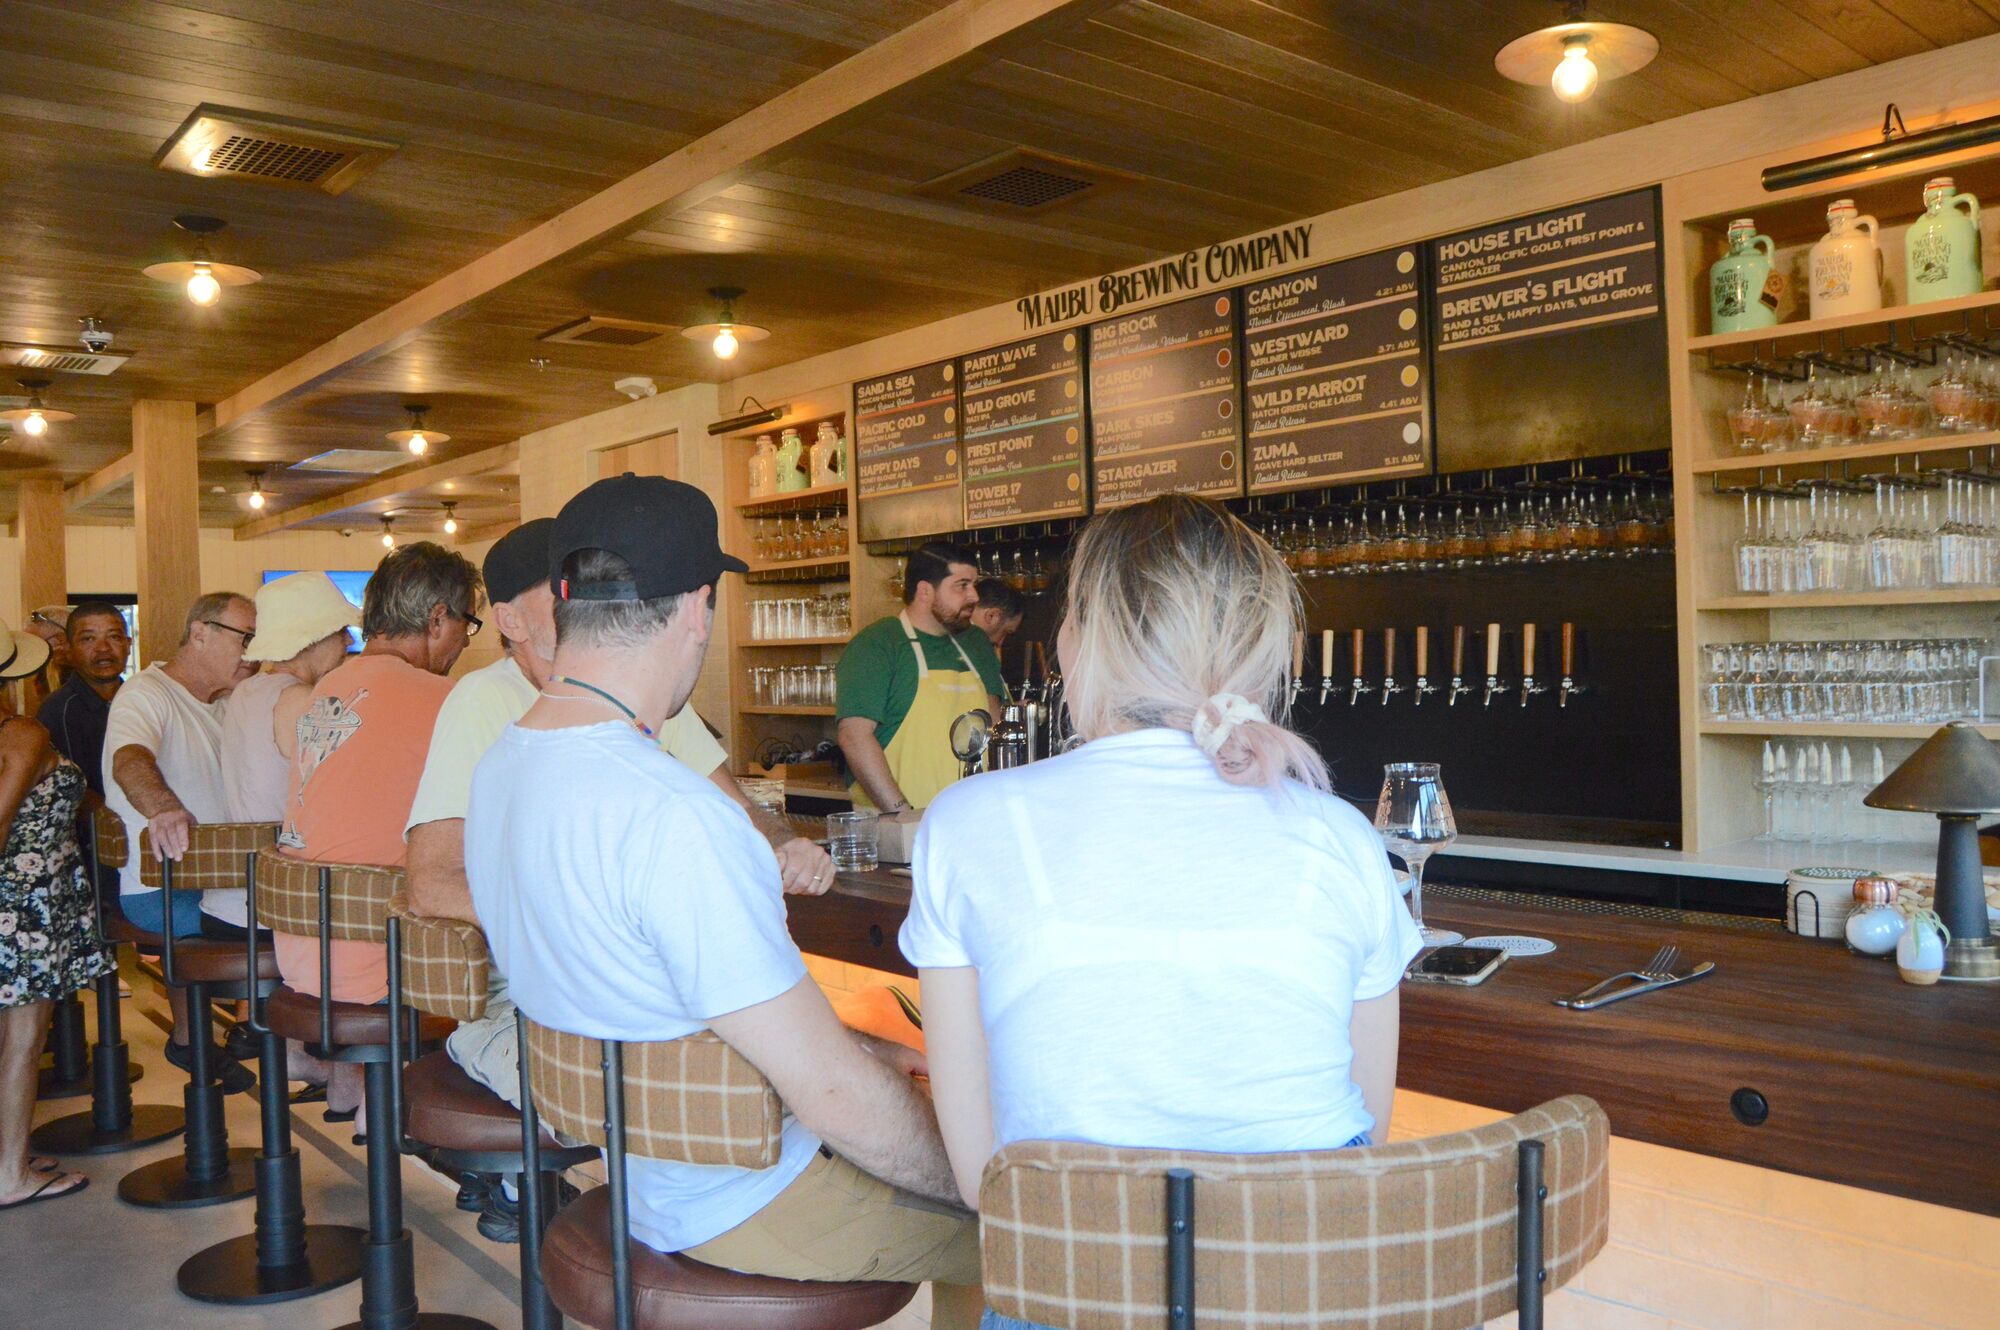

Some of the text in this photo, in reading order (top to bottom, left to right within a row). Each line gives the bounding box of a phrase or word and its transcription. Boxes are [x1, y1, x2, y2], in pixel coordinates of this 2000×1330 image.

[1440, 212, 1586, 261] HOUSE FLIGHT
[1487, 247, 1528, 264] PACIFIC
[1530, 240, 1563, 255] GOLD,
[1565, 231, 1597, 247] FIRST
[1598, 223, 1634, 240] POINT
[1017, 223, 1313, 331] MALIBU BREWING COMPANY
[1441, 263, 1501, 284] STARGAZER
[1248, 275, 1318, 306] CANYON
[1395, 282, 1415, 294] ABV
[1442, 266, 1627, 319] BREWER'S FLIGHT
[1273, 297, 1300, 310] LAGER
[1443, 319, 1472, 333] SAND
[1507, 304, 1543, 320] HAPPY
[1545, 299, 1577, 313] DAYS,
[1579, 292, 1608, 306] WILD
[1611, 283, 1653, 300] GROVE
[1093, 314, 1157, 342] BIG ROCK
[1452, 329, 1469, 341] BIG
[1471, 324, 1501, 337] ROCK
[1250, 323, 1350, 357] WESTWARD
[1398, 339, 1417, 350] ABV
[965, 344, 1037, 373] PARTY WAVE
[1251, 345, 1323, 368] BERLINER WEISSE
[1095, 365, 1153, 388] CARBON
[1277, 363, 1305, 376] Release
[858, 382, 885, 399] SAND
[895, 375, 915, 390] SEA
[1252, 374, 1368, 409] WILD PARROT
[966, 389, 1036, 415] WILD GROVE
[1252, 393, 1363, 420] HATCH GREEN CHILE LAGER
[1400, 396, 1420, 407] ABV
[860, 414, 926, 437] PACIFIC GOLD
[1096, 410, 1175, 436] DARK SKIES
[1279, 416, 1306, 428] Release
[967, 435, 1034, 458] FIRST POINT
[1254, 442, 1299, 462] ZUMA
[860, 456, 920, 477] HAPPY DAYS
[1254, 451, 1344, 472] AGAVE HARD SELTZER
[1402, 453, 1421, 464] ABV
[1098, 459, 1178, 483] STARGAZER
[1281, 469, 1309, 481] Release
[968, 482, 1022, 501] TOWER 17
[1119, 479, 1143, 489] STOUT
